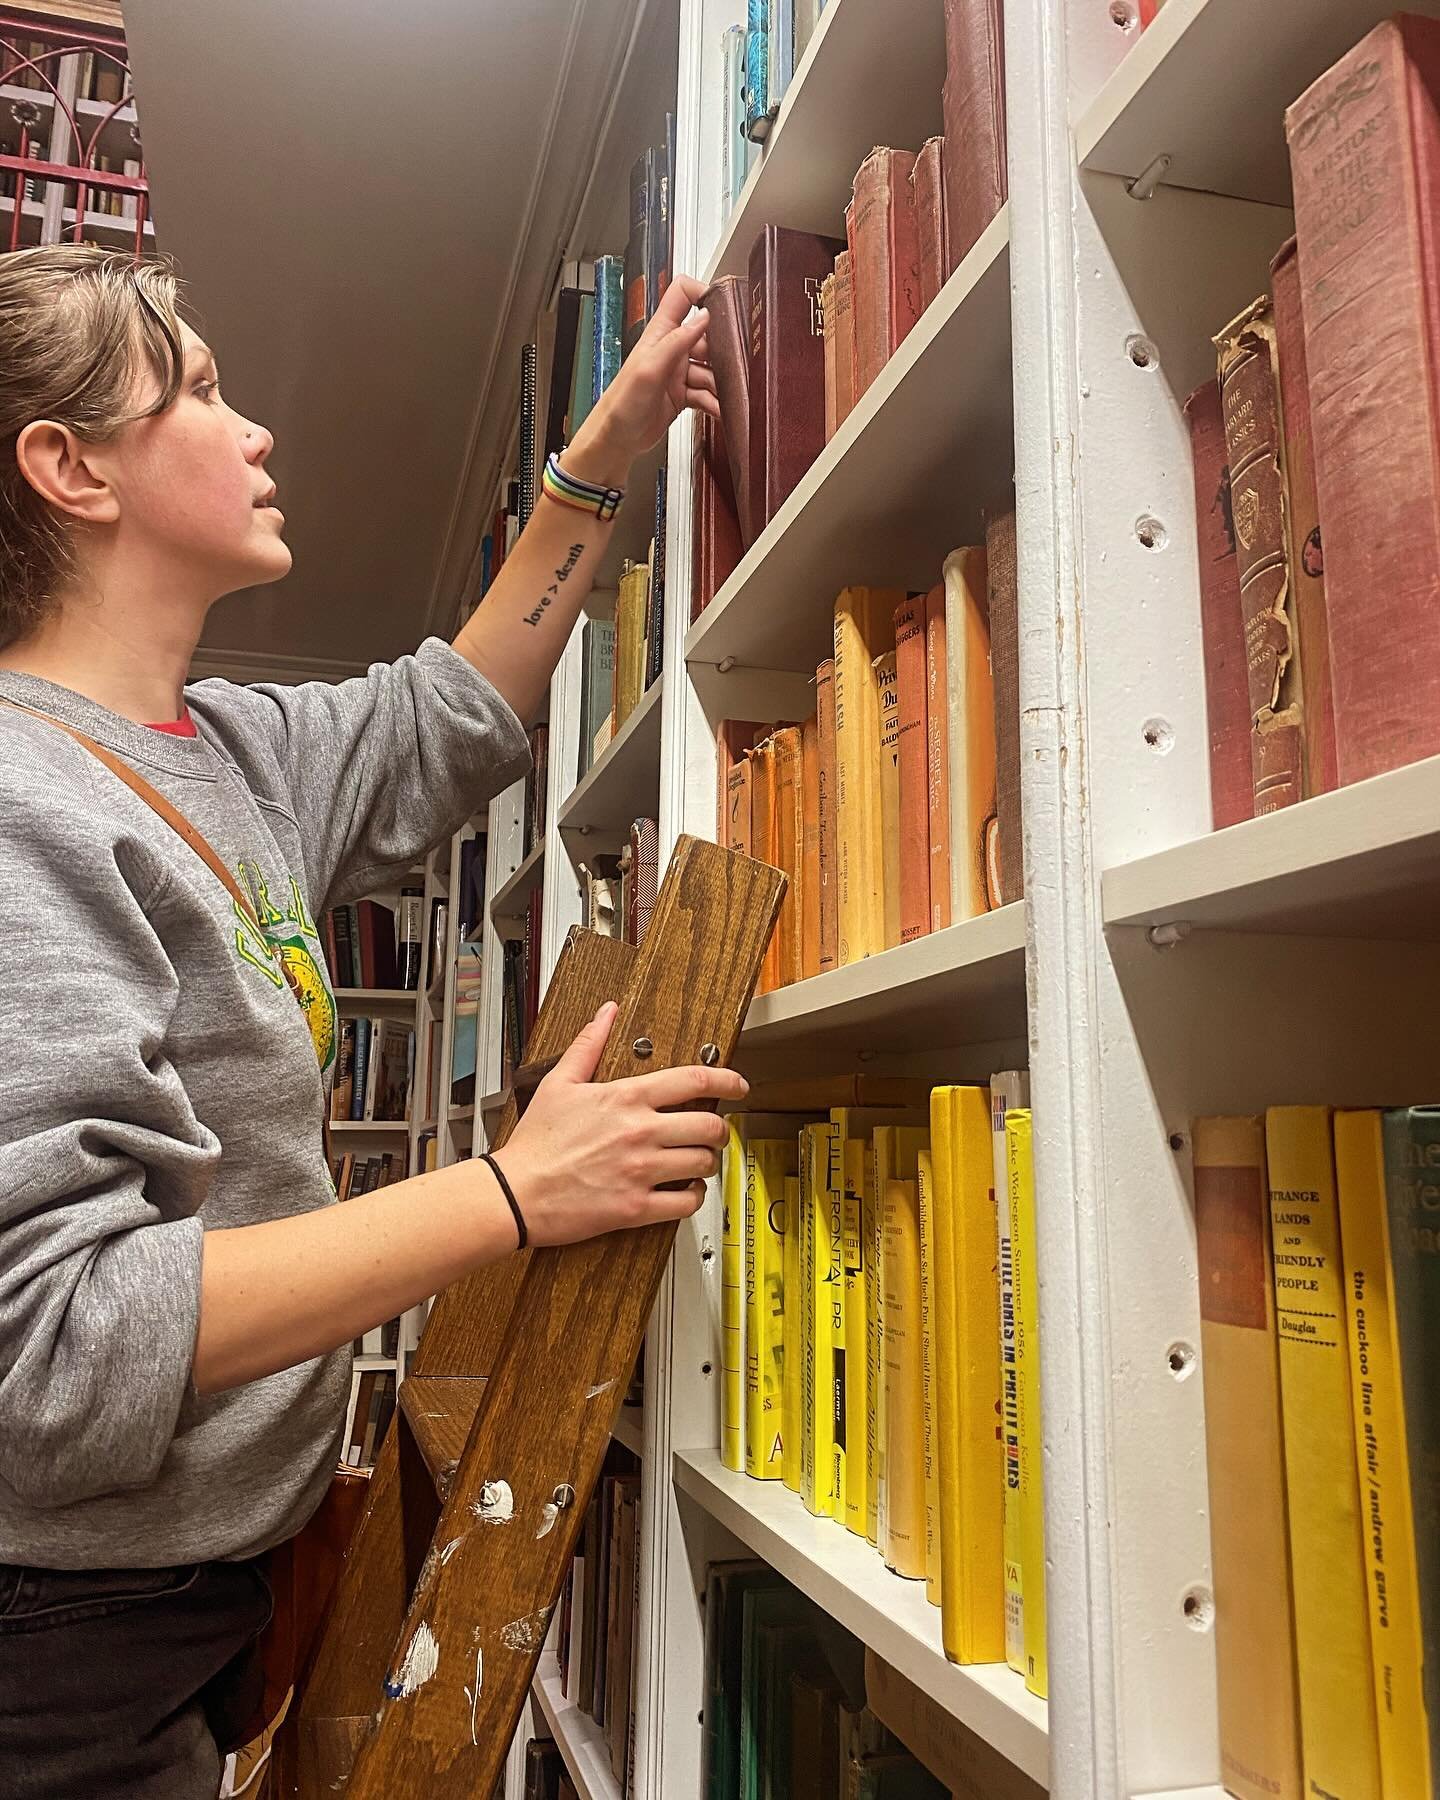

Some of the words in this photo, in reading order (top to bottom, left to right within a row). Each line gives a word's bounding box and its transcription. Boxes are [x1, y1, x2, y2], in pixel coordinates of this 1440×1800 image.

[1225, 399, 1253, 431] ARVARD
[1227, 387, 1242, 409] THE
[523, 597, 551, 627] love
[555, 543, 585, 582] death
[601, 629, 615, 641] TH
[835, 609, 843, 649] CASH
[836, 651, 843, 668] IN
[836, 672, 843, 681] A
[878, 667, 898, 689] Priv
[836, 685, 844, 732] FLASH
[882, 689, 898, 709] Du
[934, 731, 942, 786] SECRET
[818, 770, 827, 816] Caribou
[820, 820, 828, 869] Traveler
[901, 925, 921, 938] ROSSET
[355, 1068, 363, 1100] STRATEGY
[830, 1122, 840, 1171] FULL
[1008, 1131, 1017, 1165] Lake
[747, 1154, 756, 1192] TESS
[919, 1169, 928, 1240] Grandchildren
[1009, 1171, 1019, 1242] Wobegon
[1274, 1213, 1311, 1225] LANDS
[746, 1197, 756, 1305] GERRITSEN
[831, 1189, 841, 1287] FRONTAL
[920, 1241, 928, 1258] Are
[1283, 1237, 1301, 1245] AND
[921, 1260, 928, 1273] So
[1001, 1237, 1013, 1286] LITTLE
[1013, 1249, 1023, 1313] Summer
[921, 1274, 929, 1304] Much
[1276, 1277, 1319, 1291] PEOPLE
[1353, 1270, 1364, 1301] the
[832, 1302, 842, 1330] PR
[1003, 1290, 1015, 1340] GIRLS
[1281, 1317, 1316, 1334] Douglas
[1004, 1345, 1016, 1363] IN
[1017, 1319, 1025, 1359] 1956
[1355, 1308, 1369, 1376] cuckoo
[749, 1354, 759, 1393] THE
[1005, 1368, 1018, 1429] PRETTY
[1018, 1371, 1028, 1439] Garrison
[1361, 1381, 1373, 1416] line
[1006, 1433, 1020, 1490] BOXES
[1364, 1423, 1378, 1475] affair
[1020, 1445, 1032, 1497] Keillor
[1367, 1478, 1380, 1488] /
[1369, 1489, 1384, 1563] andrew
[1006, 1563, 1018, 1583] YA
[1373, 1569, 1390, 1629] garve
[1383, 1665, 1393, 1714] Harper
